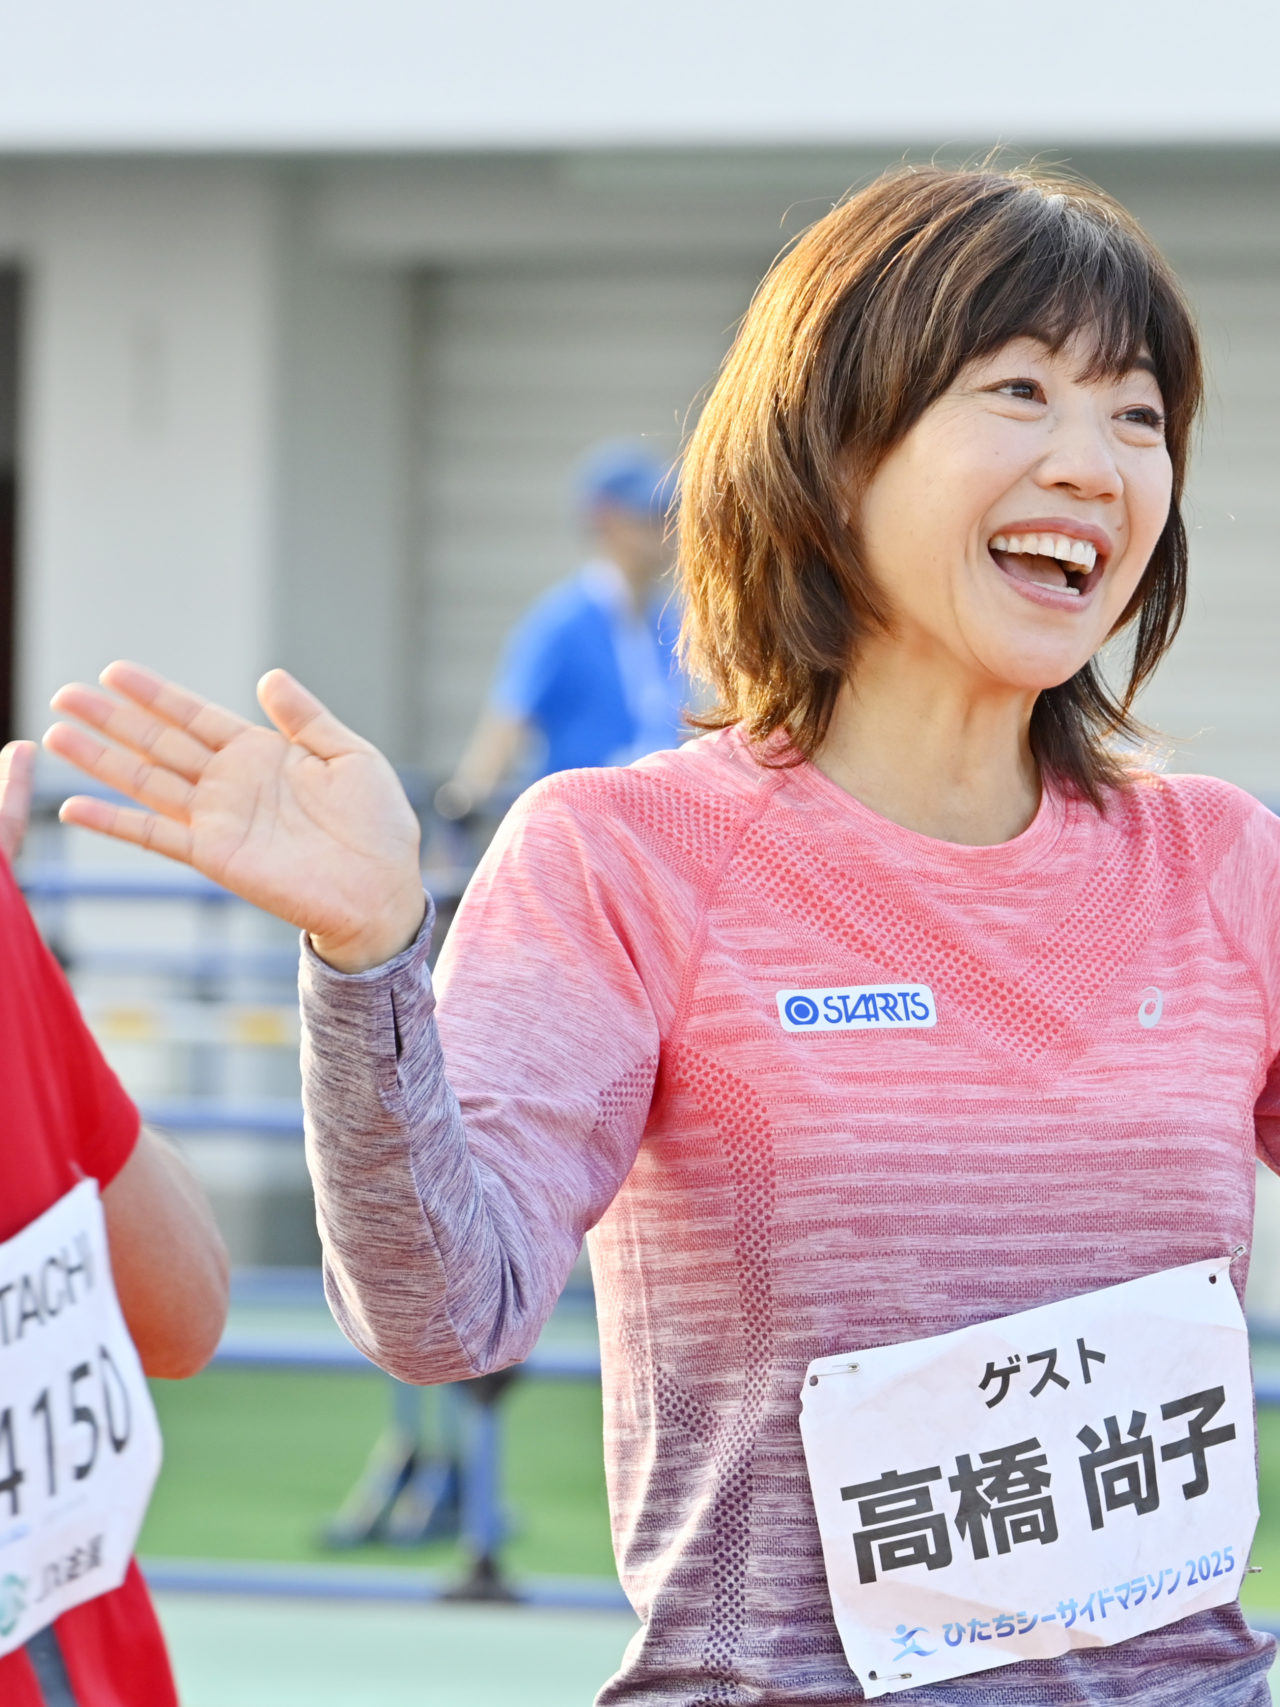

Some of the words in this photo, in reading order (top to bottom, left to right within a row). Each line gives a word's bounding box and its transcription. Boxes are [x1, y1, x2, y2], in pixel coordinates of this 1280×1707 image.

[823, 992, 930, 1024] STARTS
[978, 1338, 1106, 1408] ゲスト
[0, 1343, 131, 1516] 4150
[840, 1437, 1059, 1584] 高橋
[1076, 1385, 1237, 1531] 尚子
[942, 1567, 1182, 1648] ひたちシーサイドマラソン
[1186, 1545, 1236, 1587] 2025
